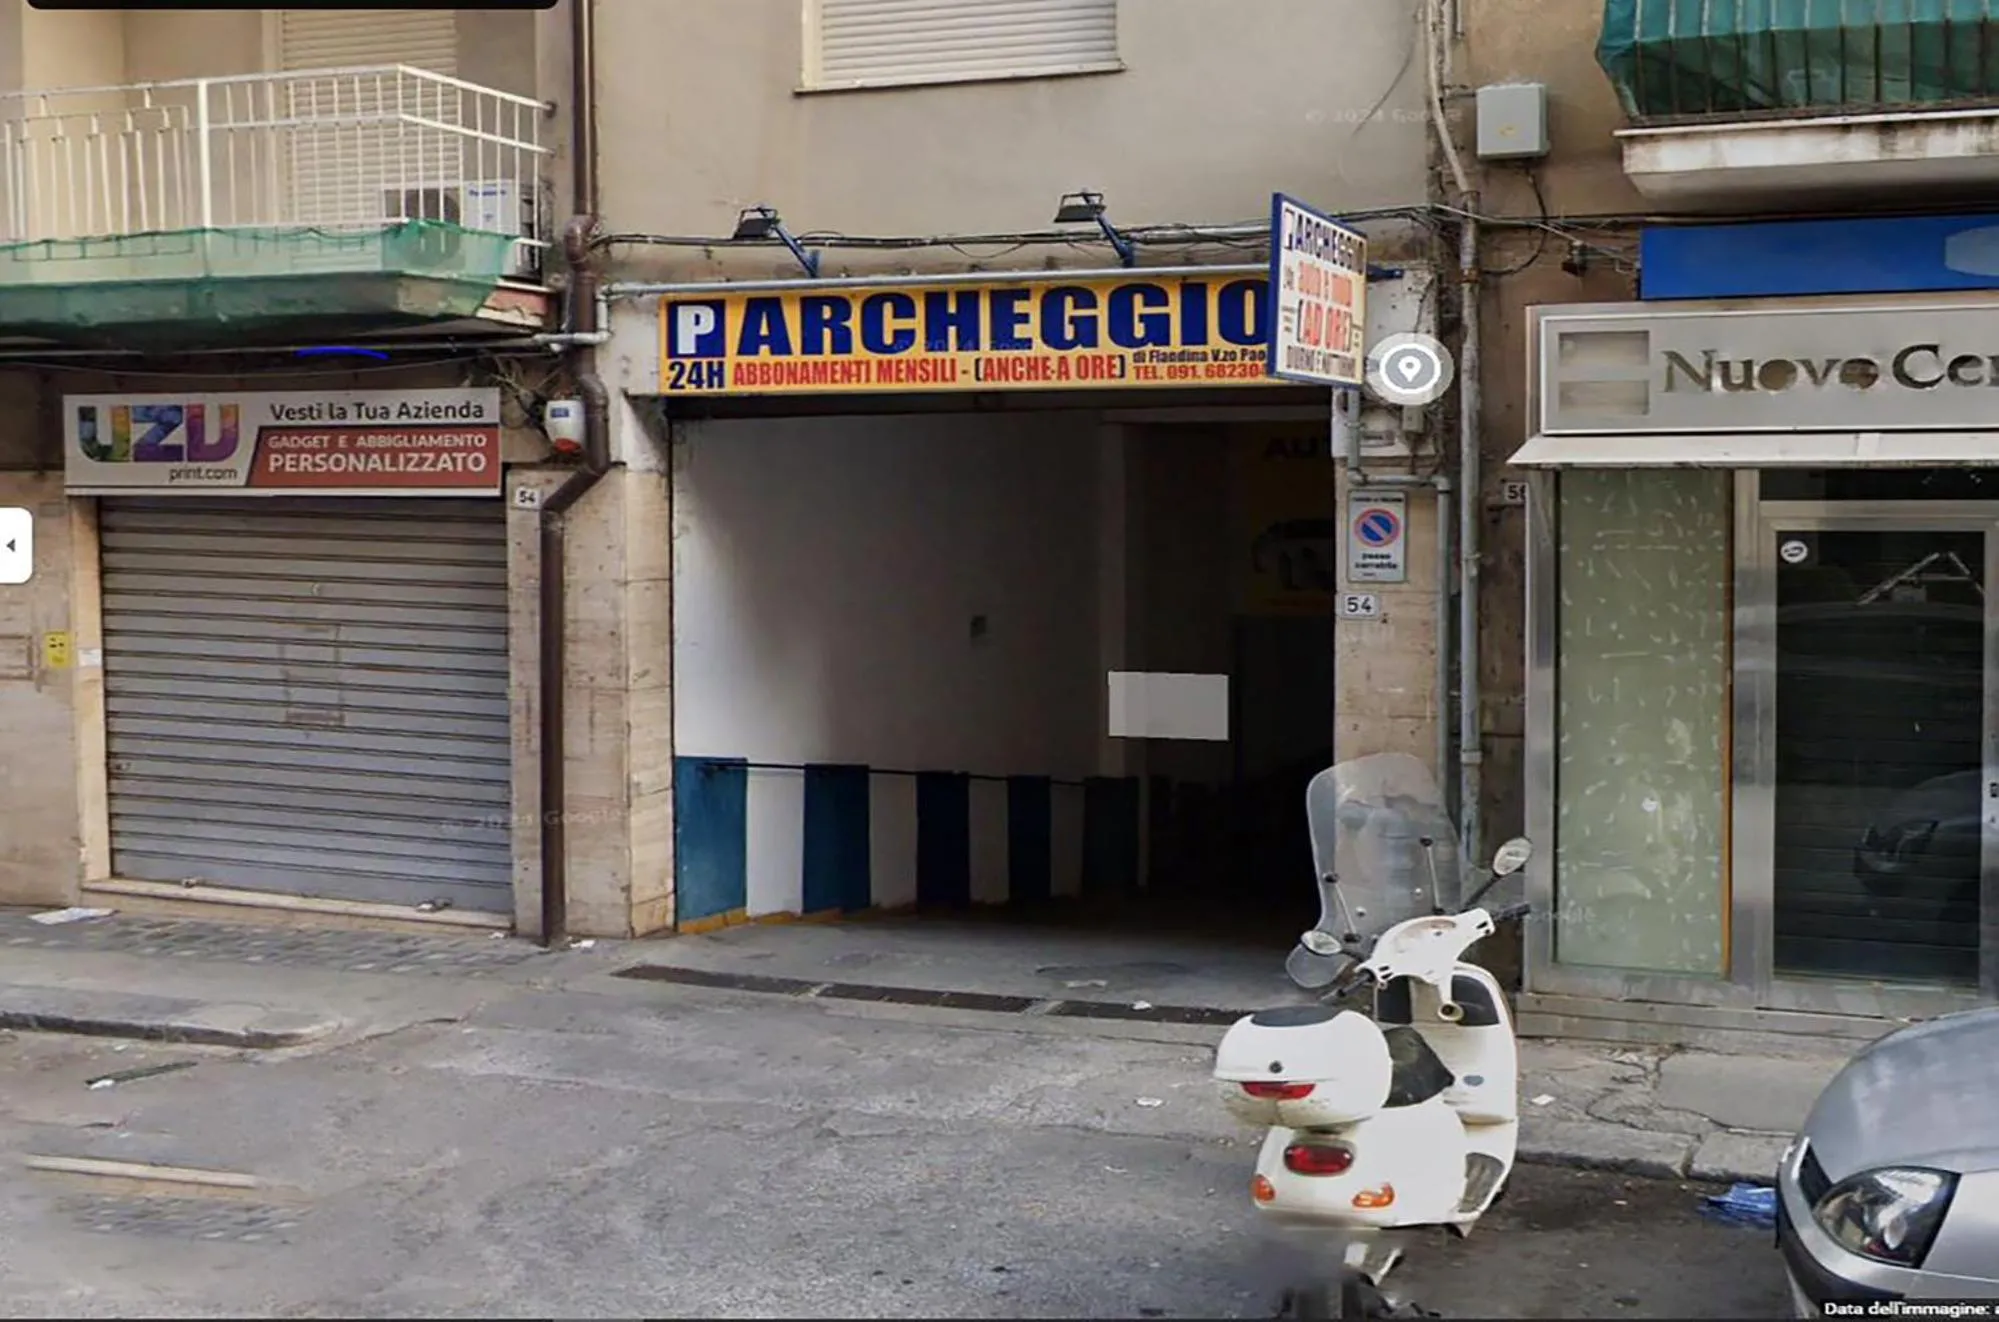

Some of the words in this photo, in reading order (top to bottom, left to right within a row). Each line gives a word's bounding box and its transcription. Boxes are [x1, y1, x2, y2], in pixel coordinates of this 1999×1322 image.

[668, 360, 725, 390] 24H
[733, 358, 871, 386] ABBONAMENTI
[876, 357, 958, 384] MENSILI
[1661, 348, 1880, 393] Nuovo
[269, 403, 323, 421] Vesti
[328, 402, 348, 420] la
[353, 401, 391, 420] Tua
[396, 400, 485, 420] Azienda
[267, 435, 330, 450] GADGET
[338, 435, 349, 449] E
[356, 433, 488, 449] ABBIGLIAMENTO
[268, 451, 488, 474] PERSONALIZZATO
[169, 466, 238, 483] print.com
[519, 489, 537, 504] 54
[1346, 595, 1373, 614] 54
